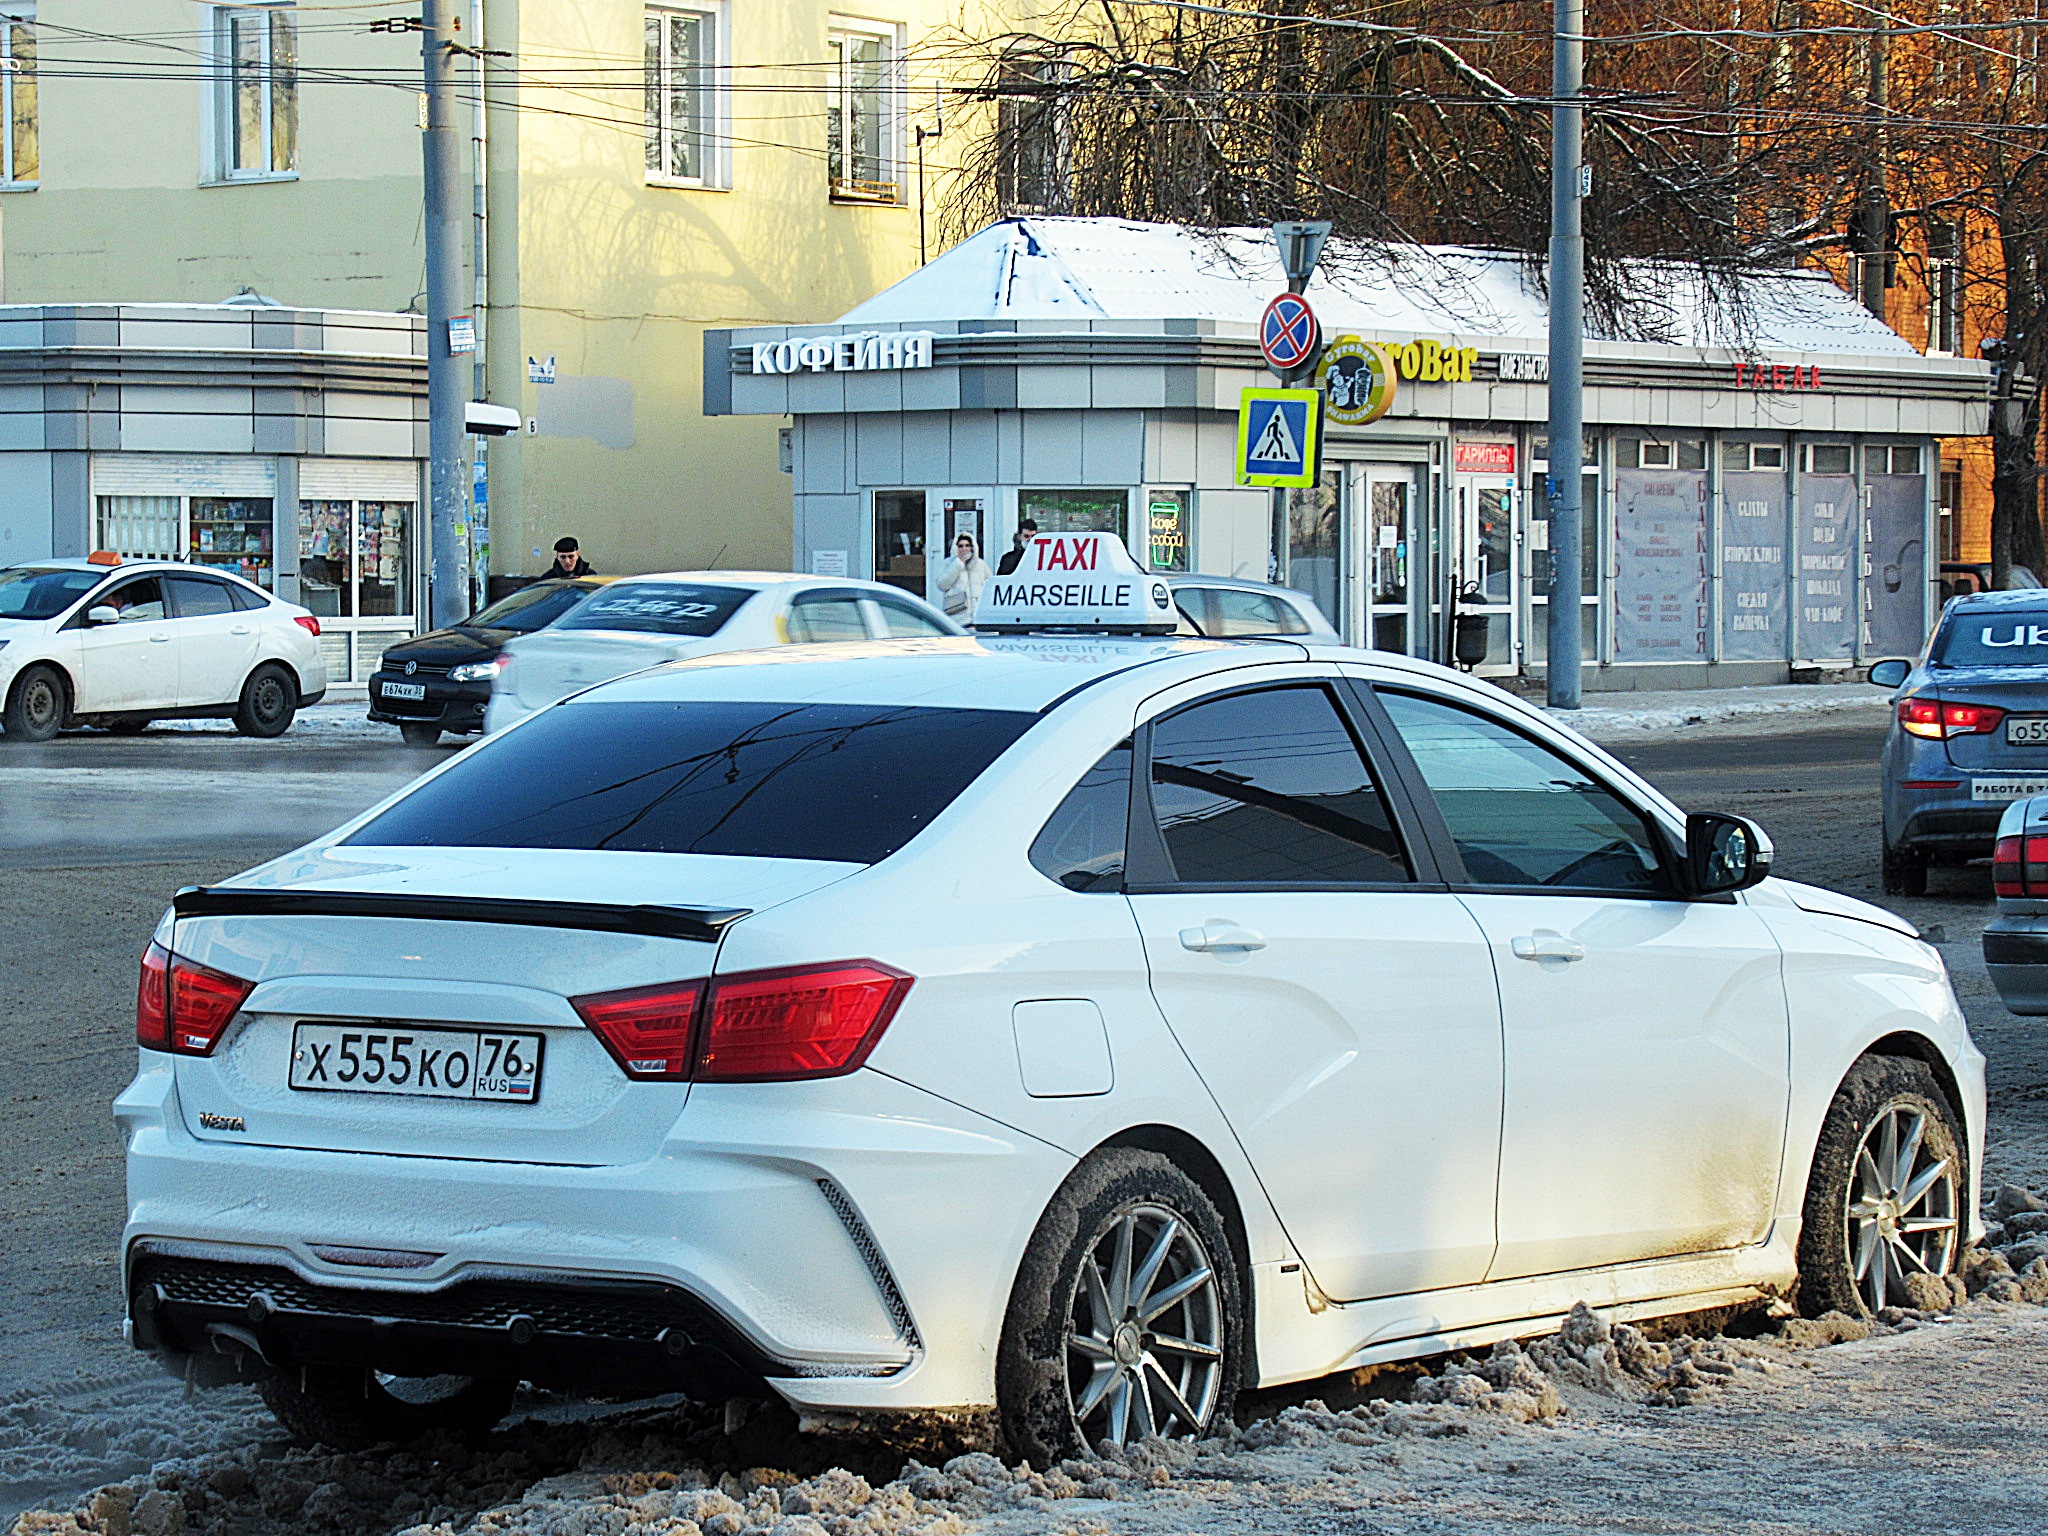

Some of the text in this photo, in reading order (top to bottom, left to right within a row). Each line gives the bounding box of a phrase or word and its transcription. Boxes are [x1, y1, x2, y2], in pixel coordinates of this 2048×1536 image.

[752, 331, 933, 374] КОФЕЙНЯ
[1500, 354, 1517, 379] КАФЕ
[1732, 363, 1823, 390] ТАБАК
[530, 420, 536, 433] 6
[1034, 538, 1099, 571] TAXI
[1696, 480, 1708, 654] БАКАЛЕЯ
[1864, 484, 1873, 645] ТАБАК
[993, 584, 1131, 607] MARSEILLE
[1975, 785, 2023, 794] РАБОТА
[2026, 785, 2034, 794] В
[307, 1033, 524, 1089] Х555КО 76
[477, 1077, 508, 1093] RUS
